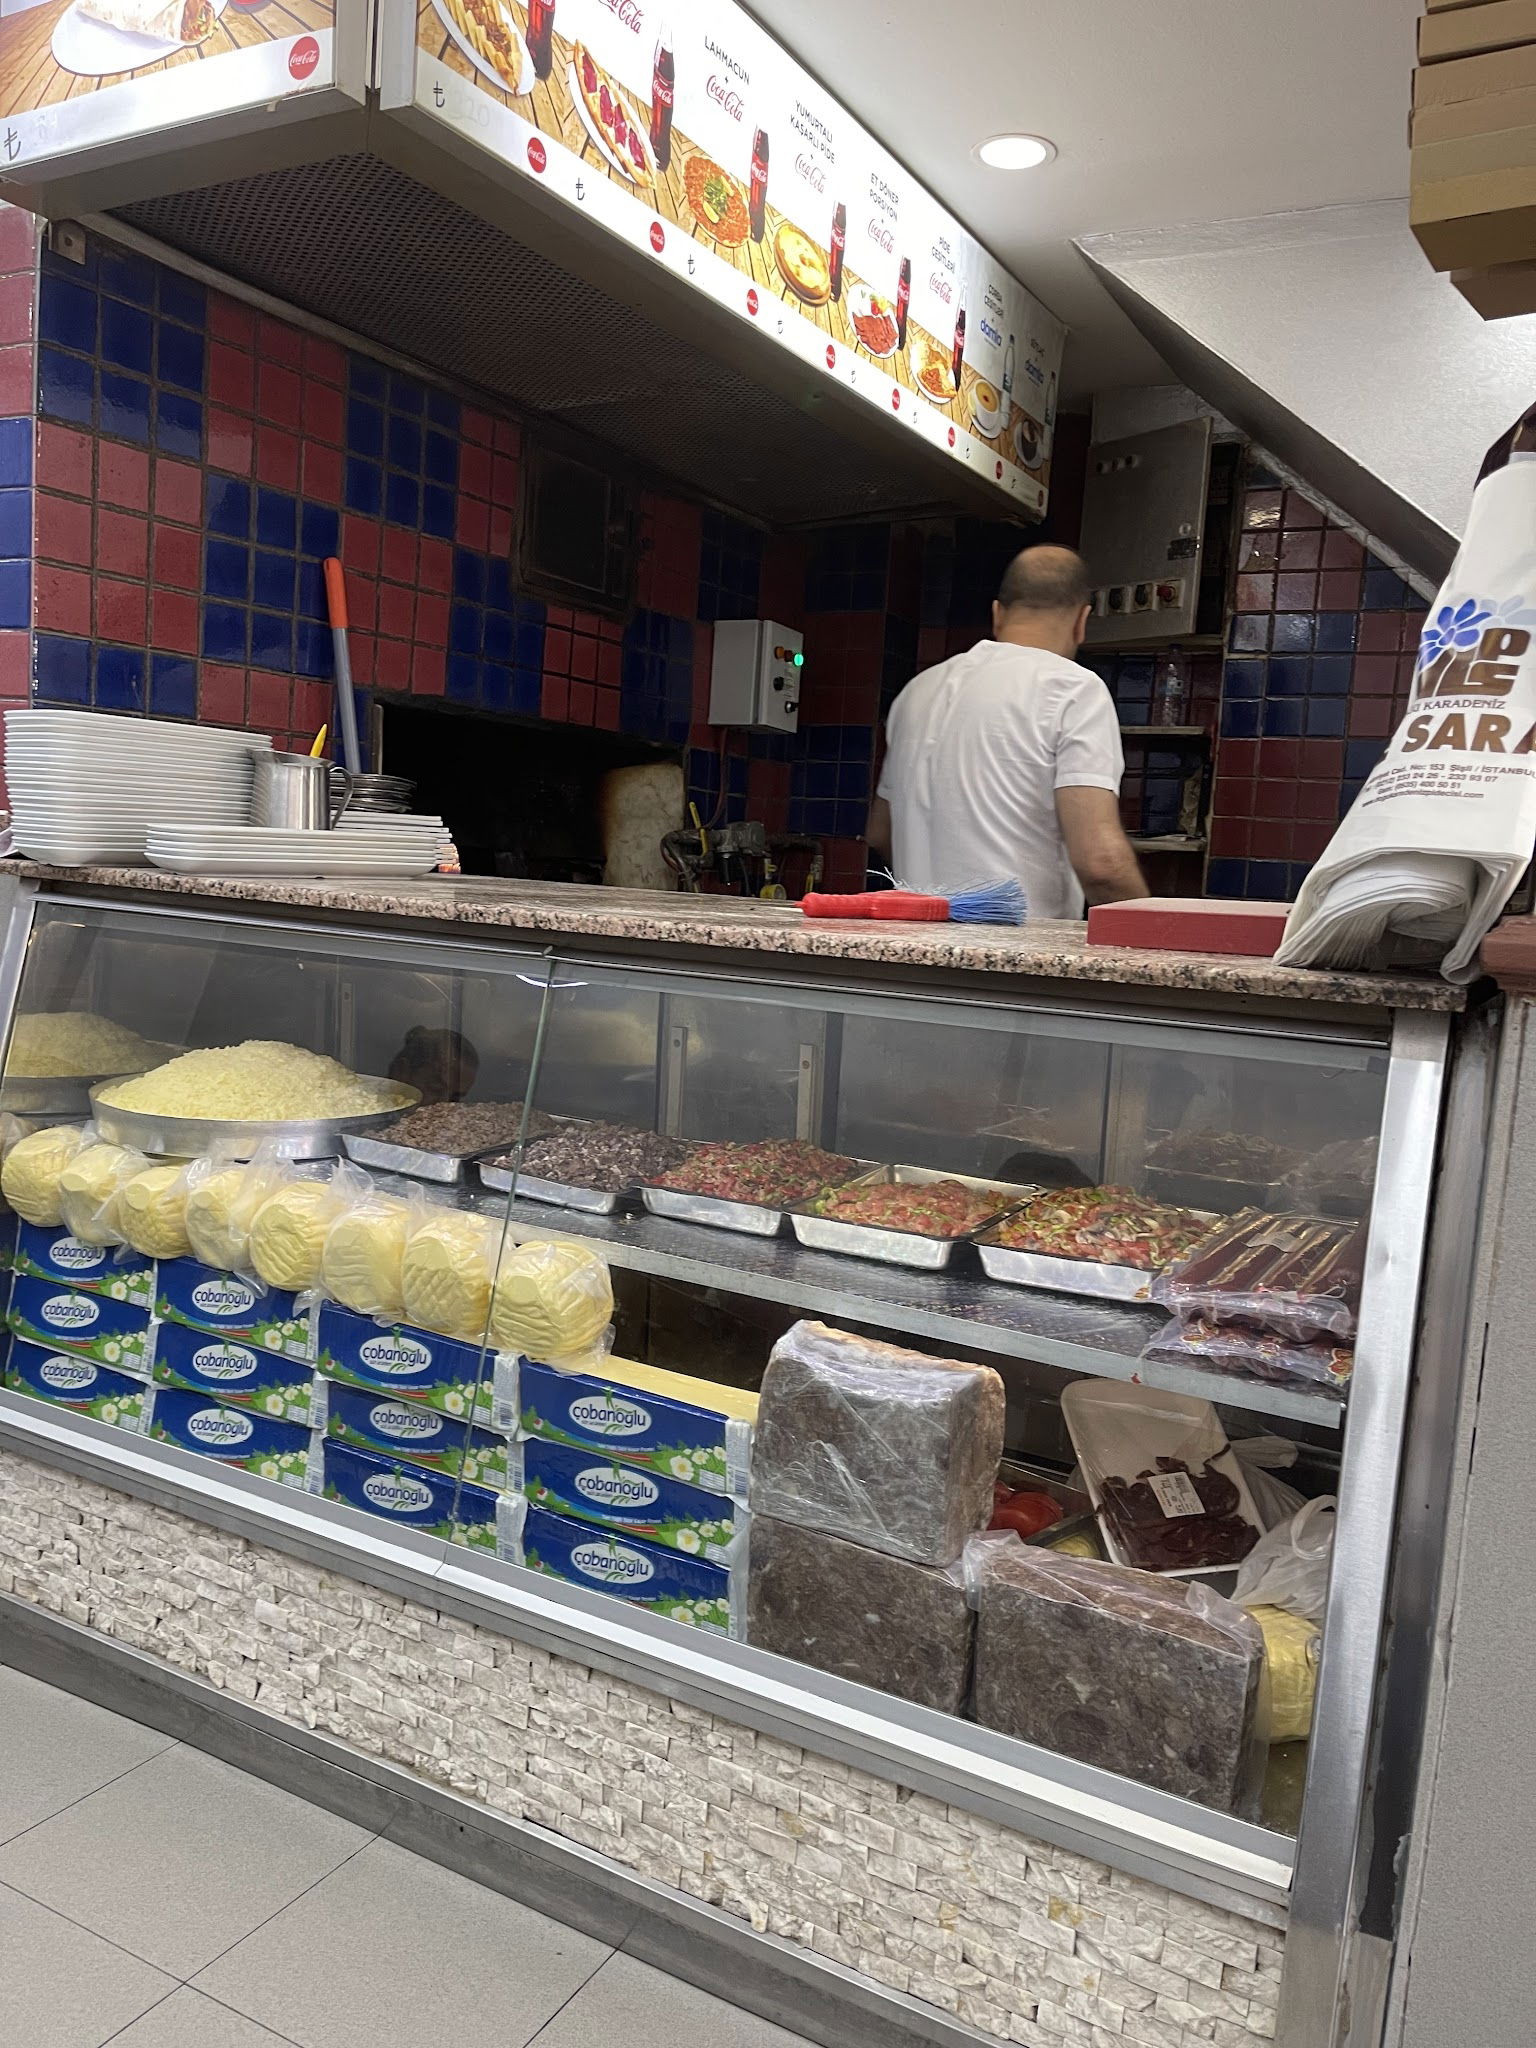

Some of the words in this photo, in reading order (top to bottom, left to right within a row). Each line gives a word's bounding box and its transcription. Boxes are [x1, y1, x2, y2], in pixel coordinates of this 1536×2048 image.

[704, 35, 750, 85] LAHMACUN
[706, 75, 744, 122] Coca-Cola
[796, 99, 833, 143] YUMURTALI
[1423, 699, 1507, 711] KARADENİZ
[1429, 763, 1446, 771] 153
